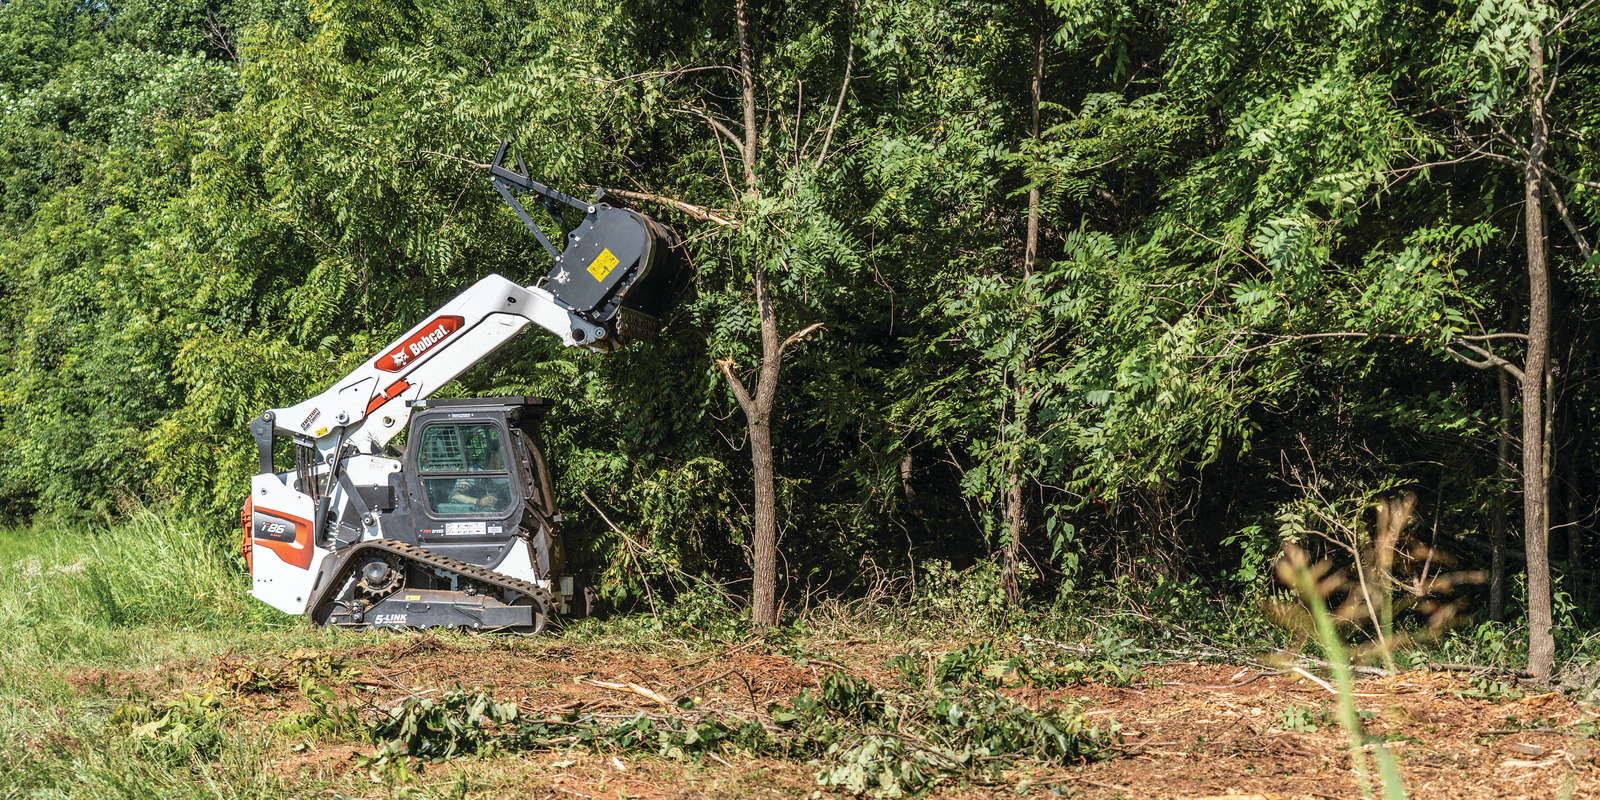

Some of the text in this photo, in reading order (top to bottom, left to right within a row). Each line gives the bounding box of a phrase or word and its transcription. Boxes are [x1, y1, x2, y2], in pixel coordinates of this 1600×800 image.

[409, 324, 448, 356] Bobcat
[261, 521, 286, 534] T86
[375, 614, 407, 624] 5-LINK
